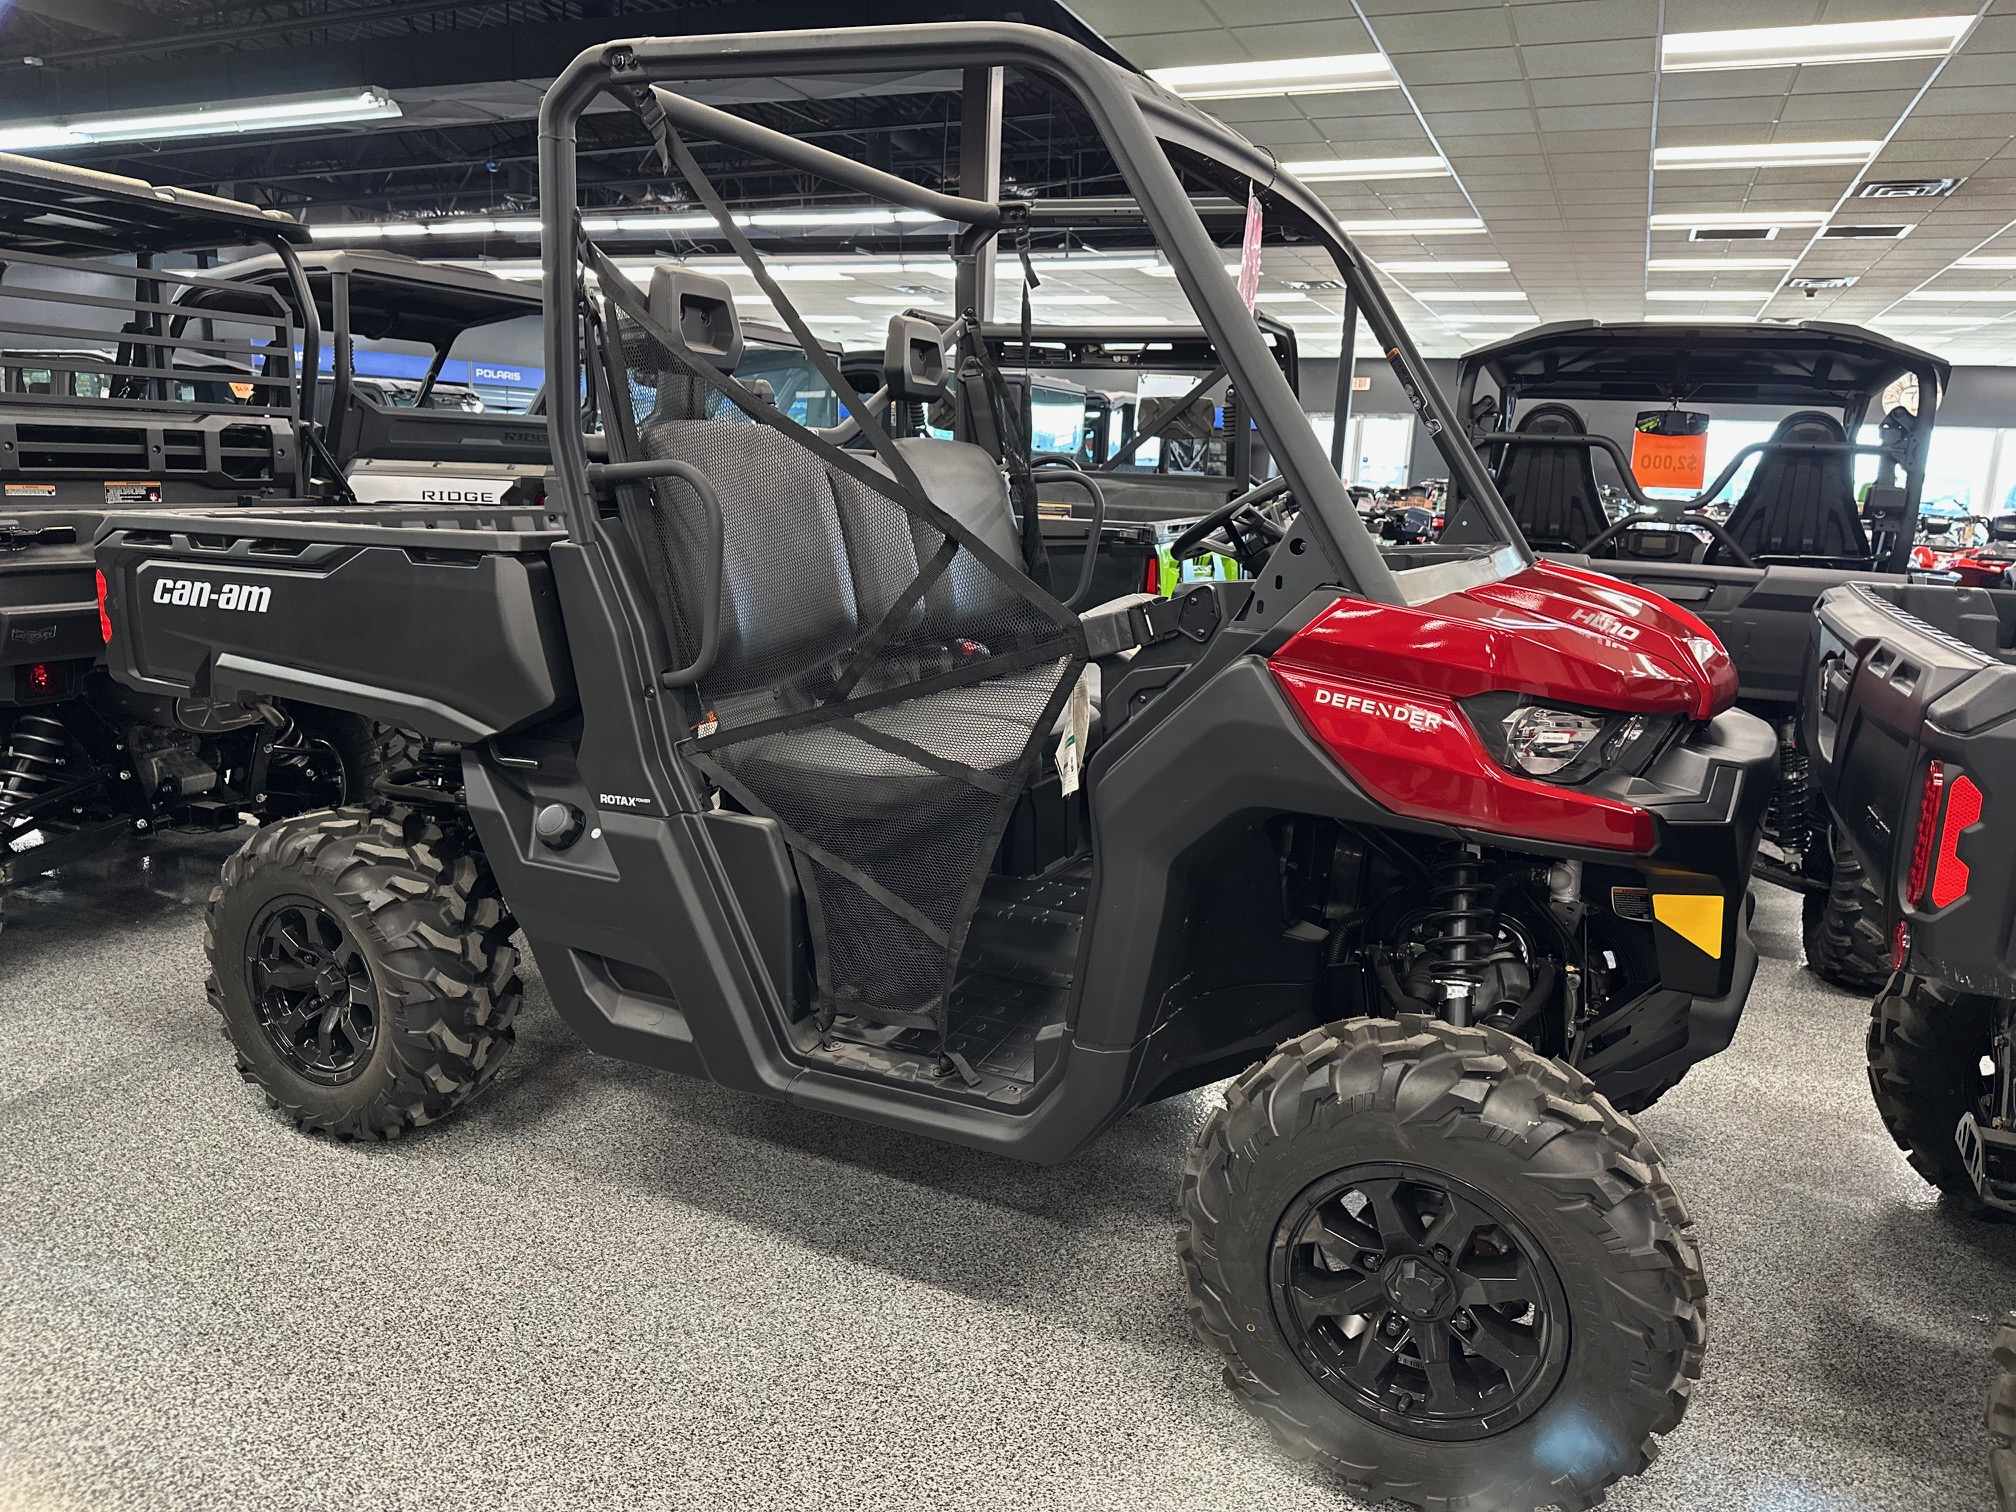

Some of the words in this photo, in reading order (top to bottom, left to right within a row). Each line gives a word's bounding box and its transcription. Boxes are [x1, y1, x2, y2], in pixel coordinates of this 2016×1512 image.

[475, 368, 521, 381] POLARIS
[504, 431, 548, 442] RIDG
[422, 490, 494, 503] RIDGE
[153, 578, 272, 612] can-am
[1315, 689, 1442, 729] DEFENDER
[600, 794, 636, 806] ROTAX
